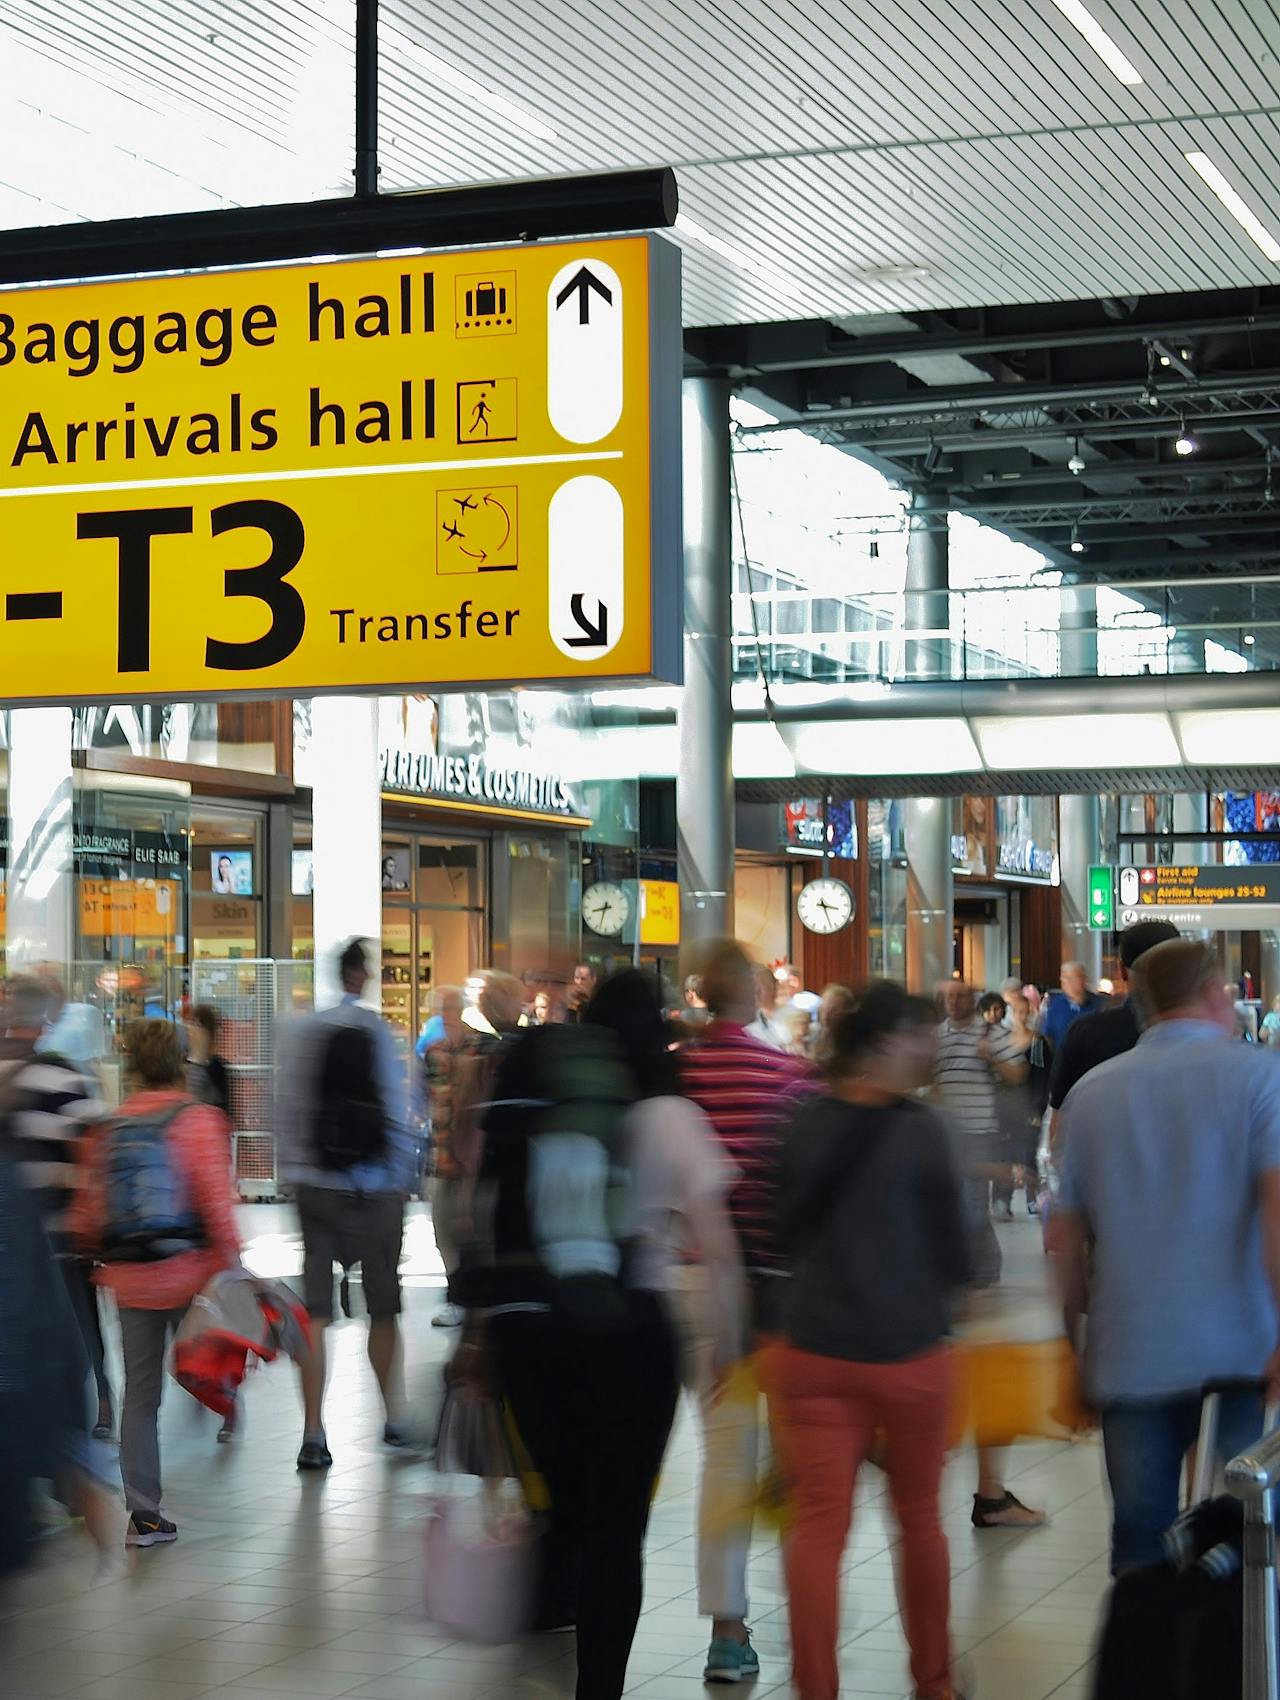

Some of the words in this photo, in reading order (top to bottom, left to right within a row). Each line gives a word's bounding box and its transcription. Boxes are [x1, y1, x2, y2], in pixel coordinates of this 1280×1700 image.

[308, 272, 436, 343] hall
[10, 392, 279, 467] Arrivals
[309, 377, 436, 448] hall
[329, 599, 520, 645] Transfer
[135, 847, 156, 863] ELIE
[1156, 866, 1180, 878] First
[1181, 866, 1199, 878] aid
[1157, 886, 1192, 898] Airline
[1193, 885, 1235, 900] lounges
[212, 902, 248, 919] Skin
